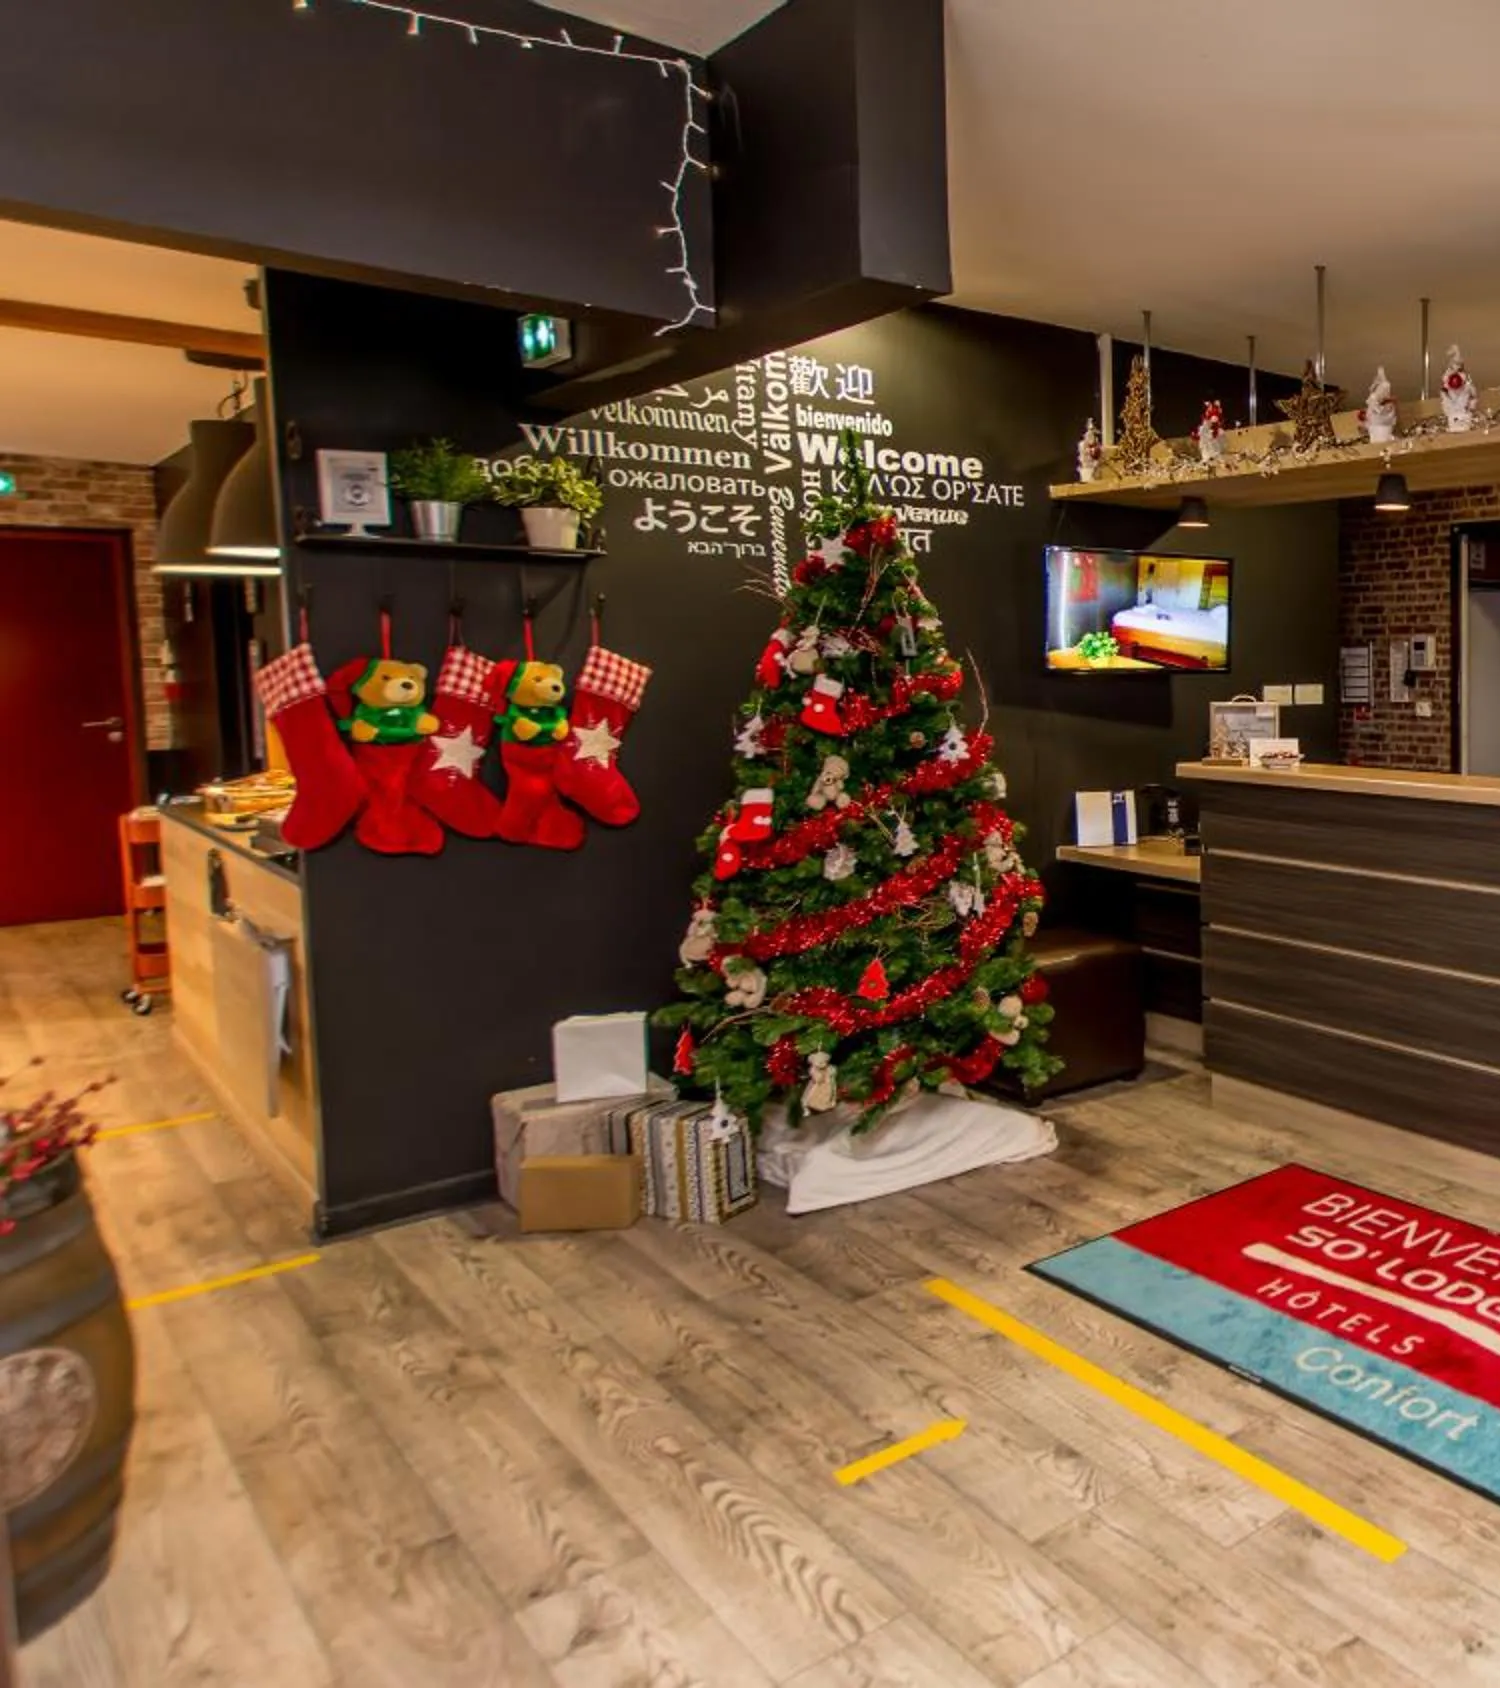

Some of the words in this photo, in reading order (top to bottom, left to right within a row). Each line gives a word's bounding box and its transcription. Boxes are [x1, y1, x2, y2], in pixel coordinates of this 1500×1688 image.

[731, 360, 761, 449] itamy
[796, 402, 893, 437] bienvenido
[518, 422, 752, 470] Willkommen
[608, 466, 766, 498] ожаловать
[633, 497, 762, 538] ようこそ
[1257, 1277, 1425, 1356] HÔTELS
[1294, 1346, 1484, 1442] Confort
